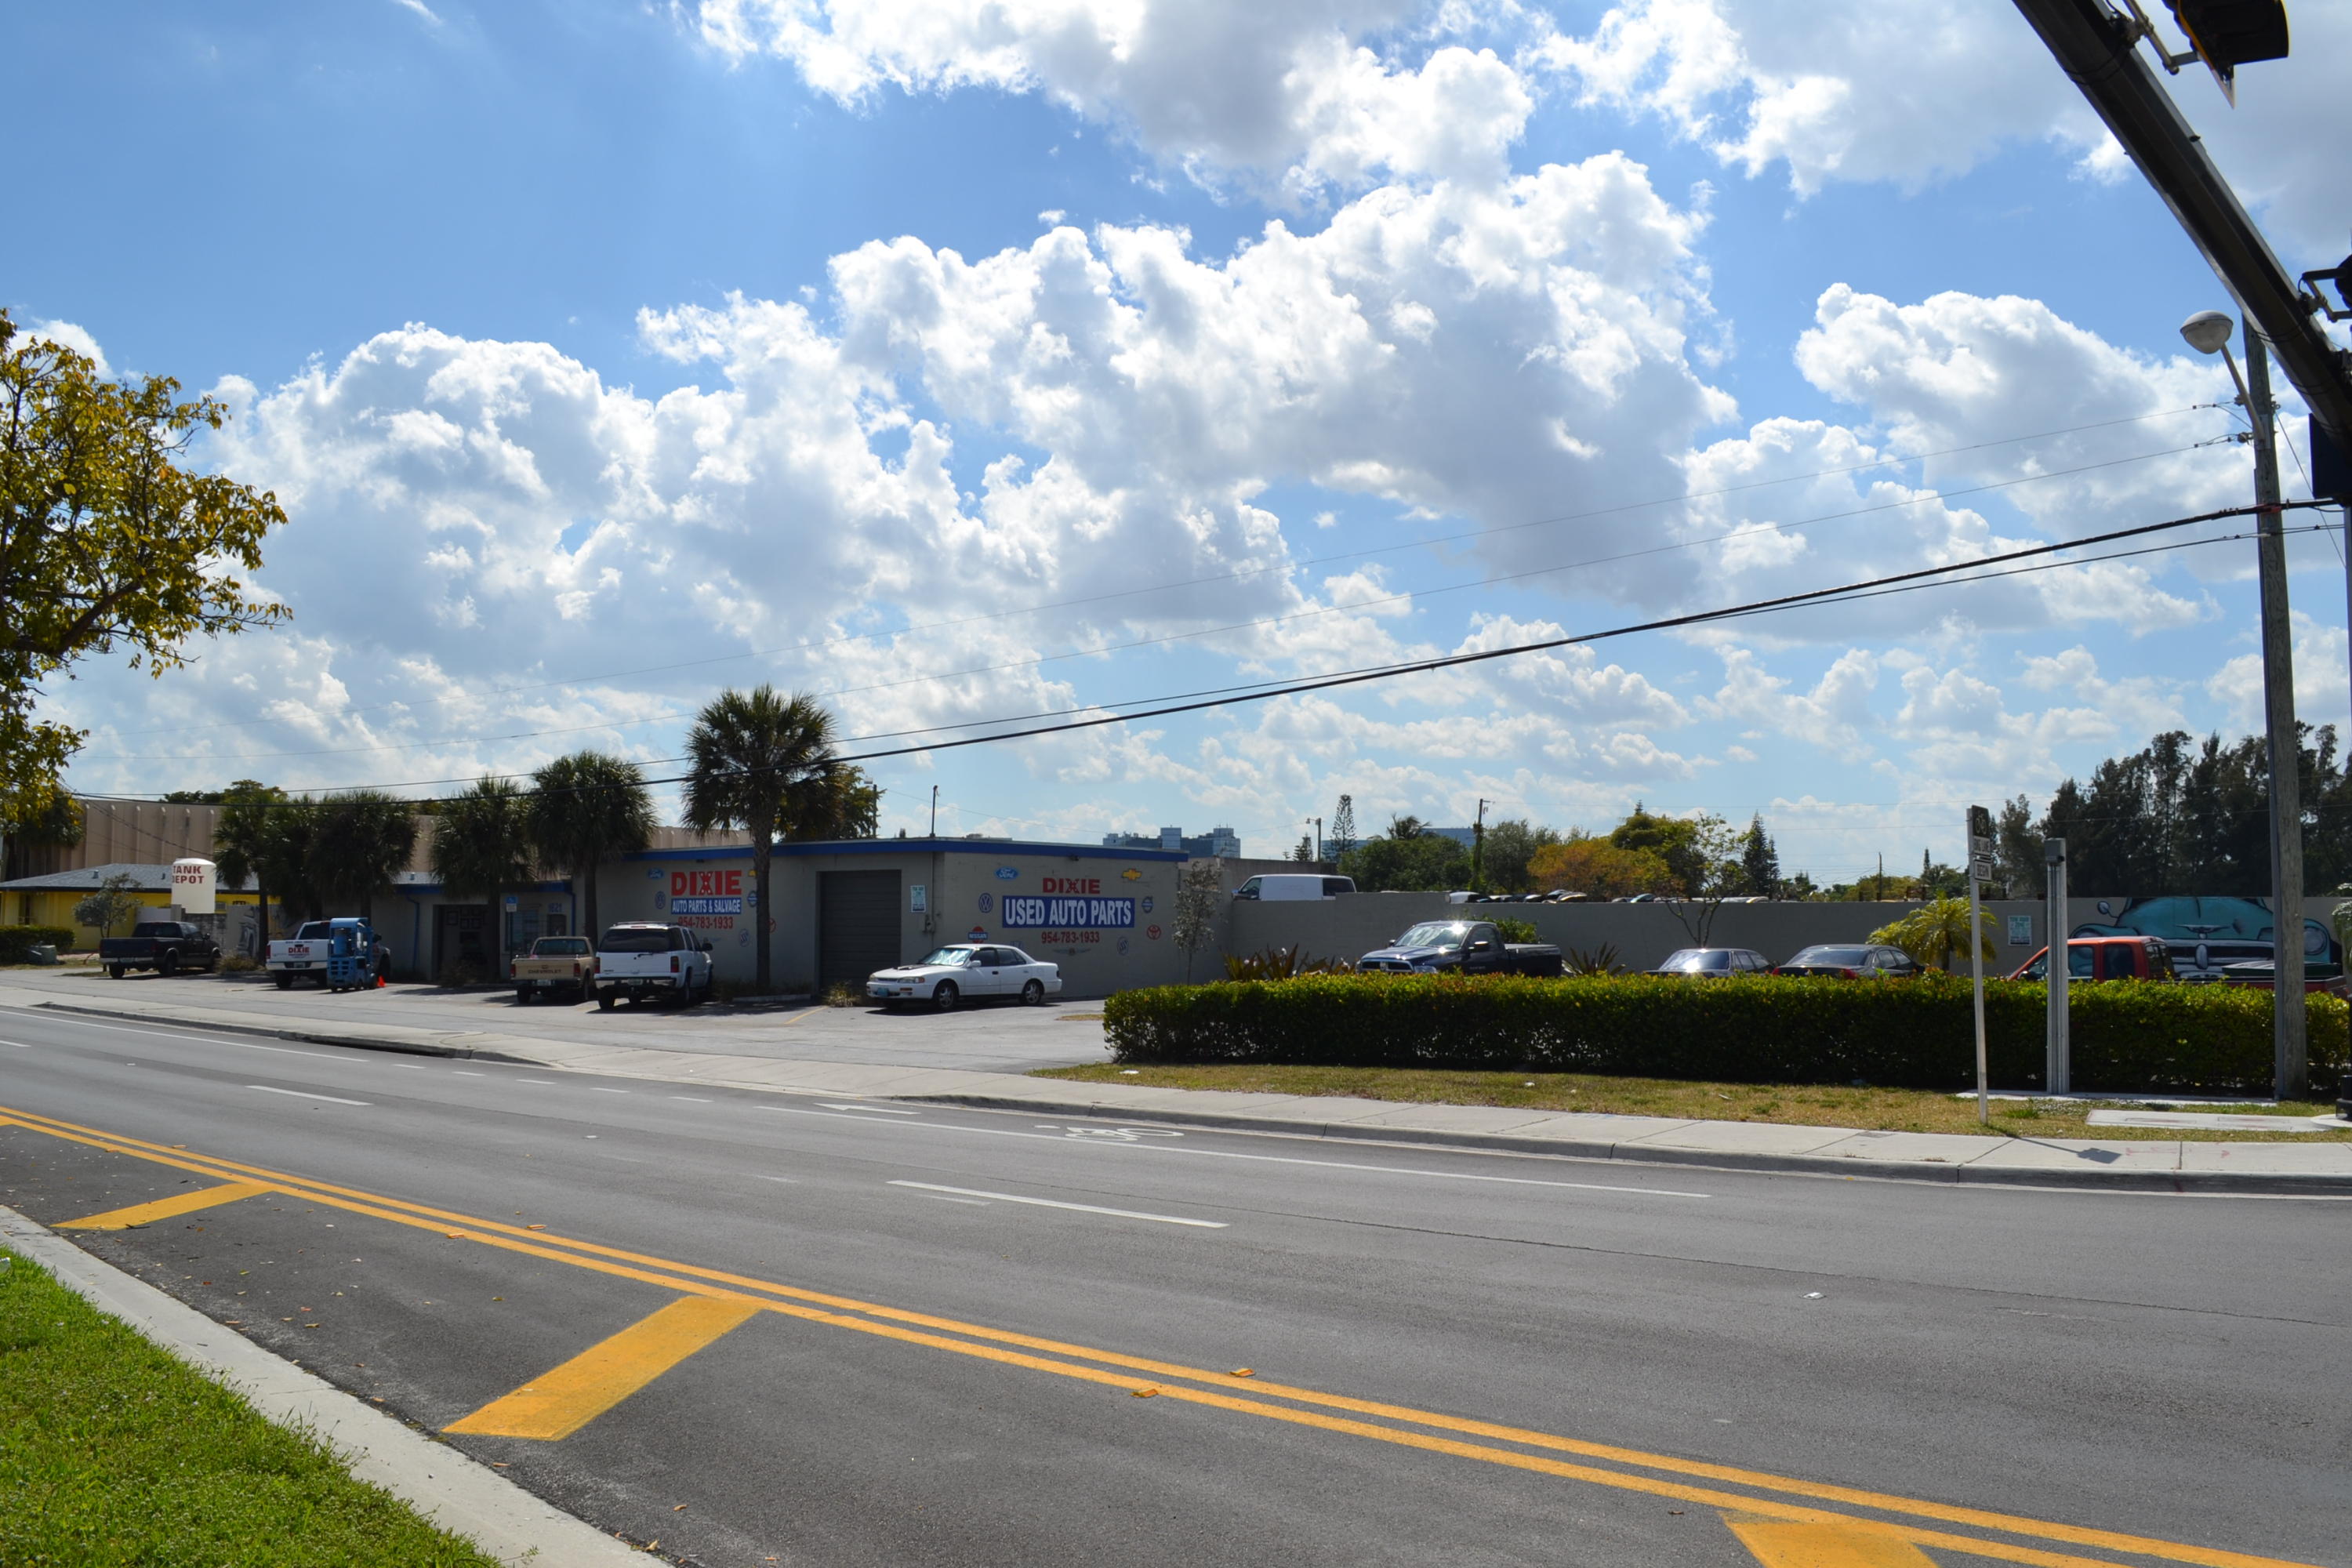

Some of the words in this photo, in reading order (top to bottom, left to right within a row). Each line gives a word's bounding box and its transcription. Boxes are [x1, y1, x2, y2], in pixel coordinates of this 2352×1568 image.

[998, 868, 1016, 878] Ford
[671, 870, 742, 895] DIXIE
[1042, 877, 1101, 894] DIXIE
[672, 899, 687, 913] AUTO
[688, 899, 707, 913] PARTS
[714, 898, 741, 913] SALVAGE
[1005, 898, 1045, 925] USED
[1049, 899, 1087, 925] AUTO
[1091, 900, 1131, 925] PARTS
[677, 916, 734, 929] 954-783-1933
[1041, 931, 1100, 944] 954-783-1933
